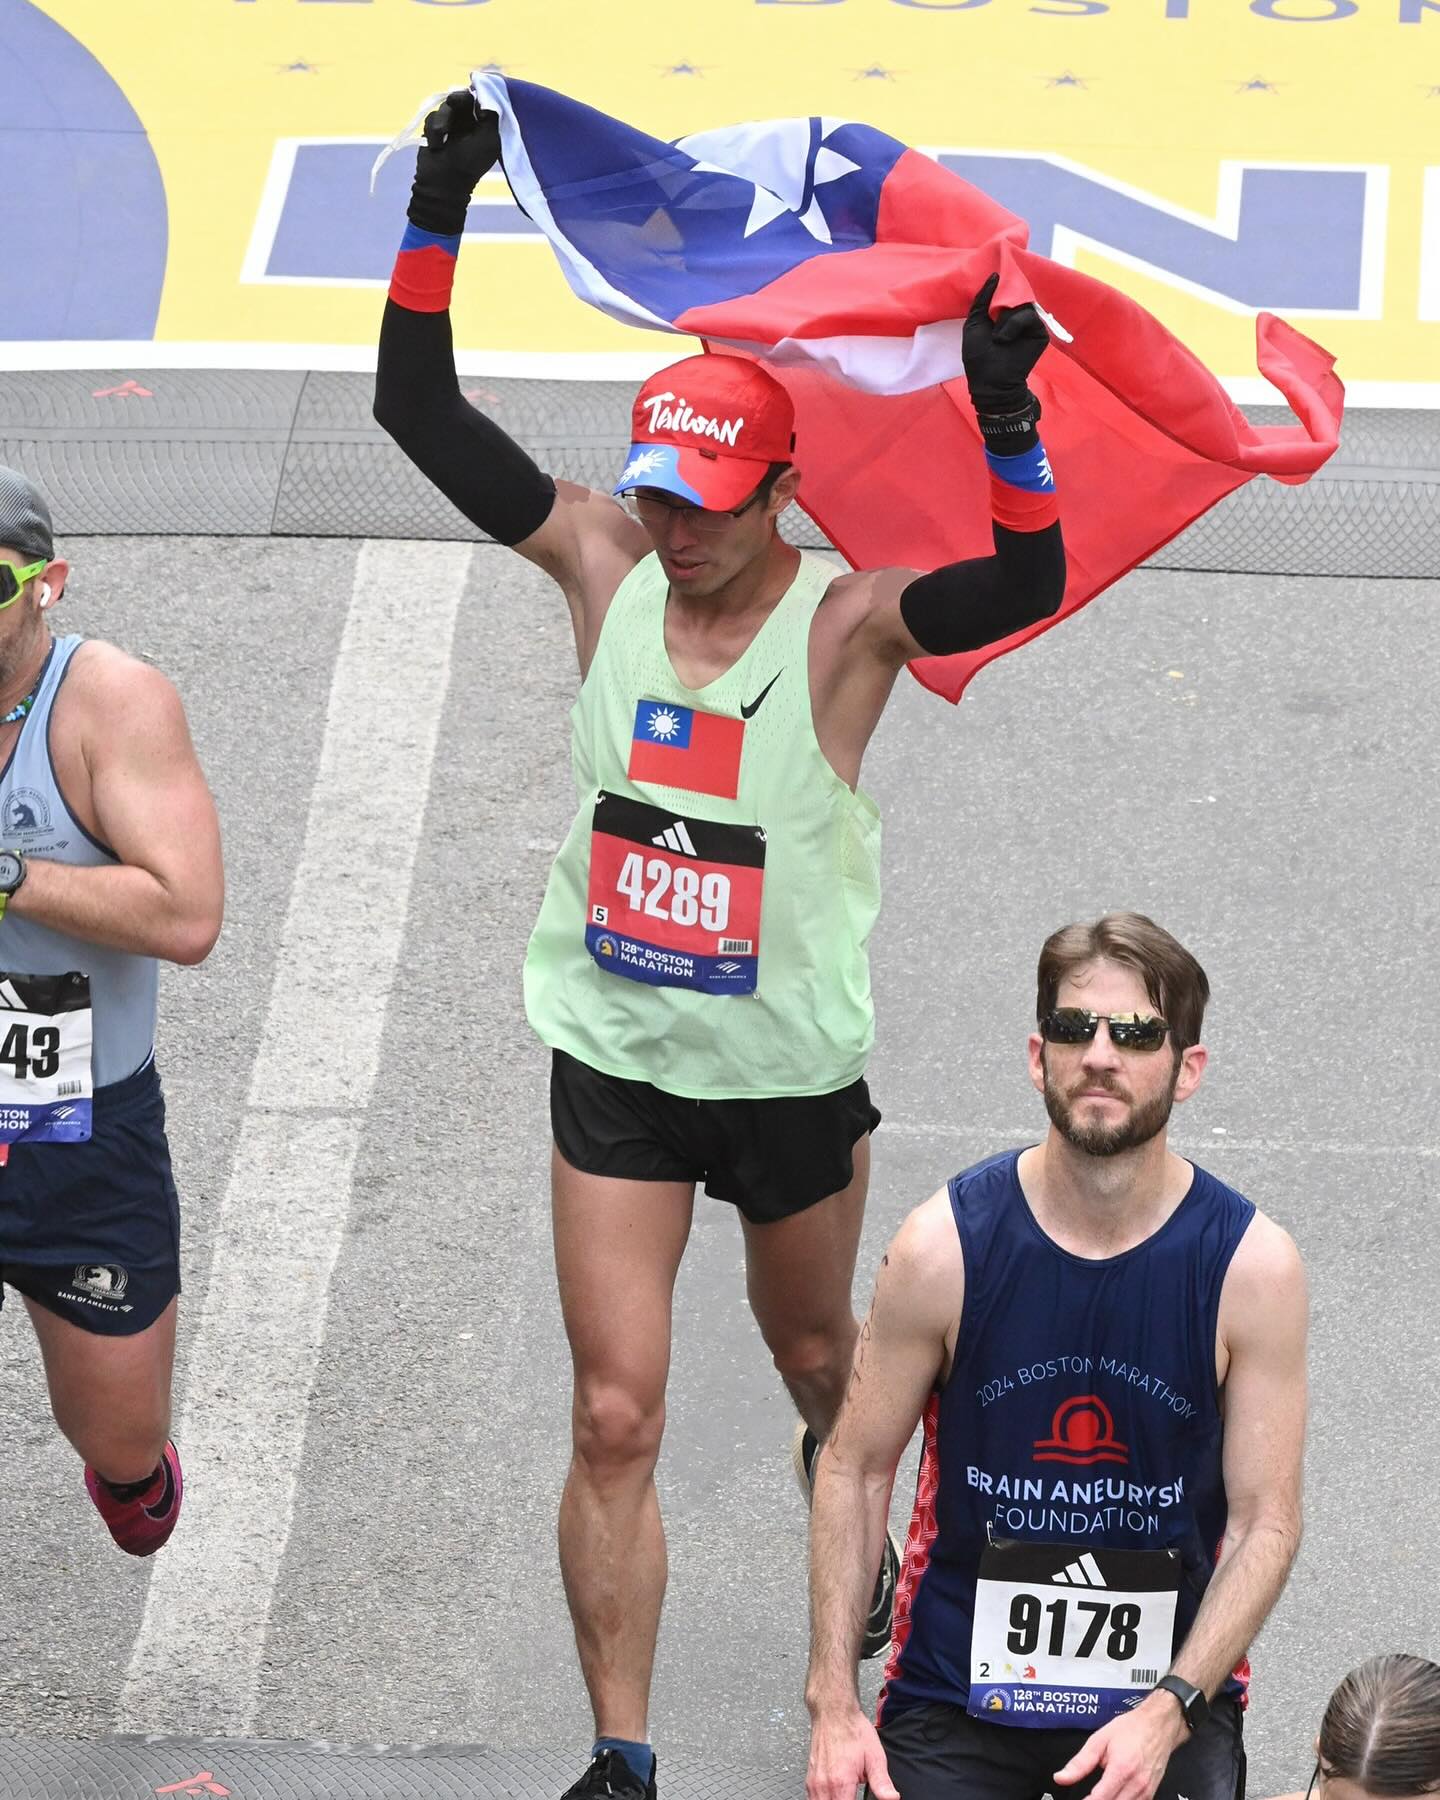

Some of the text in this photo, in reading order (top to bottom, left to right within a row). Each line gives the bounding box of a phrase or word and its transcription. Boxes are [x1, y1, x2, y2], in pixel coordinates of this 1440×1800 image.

[616, 851, 731, 932] 4289
[595, 907, 605, 922] 5
[620, 952, 694, 978] MARATHON
[645, 949, 694, 968] BOSTON
[0, 1109, 29, 1119] TON
[57, 1291, 77, 1300] BANK
[87, 1299, 118, 1311] AMERICA
[975, 1356, 1197, 1419] 2024 BOSTON MARATHON
[966, 1466, 1043, 1500] BRAIN
[995, 1504, 1159, 1535] FOUNDATION
[1007, 1593, 1142, 1661] 9178
[979, 1662, 990, 1678] 2
[1043, 1691, 1099, 1704] BOSTON
[1013, 1701, 1098, 1715] MARATHON
